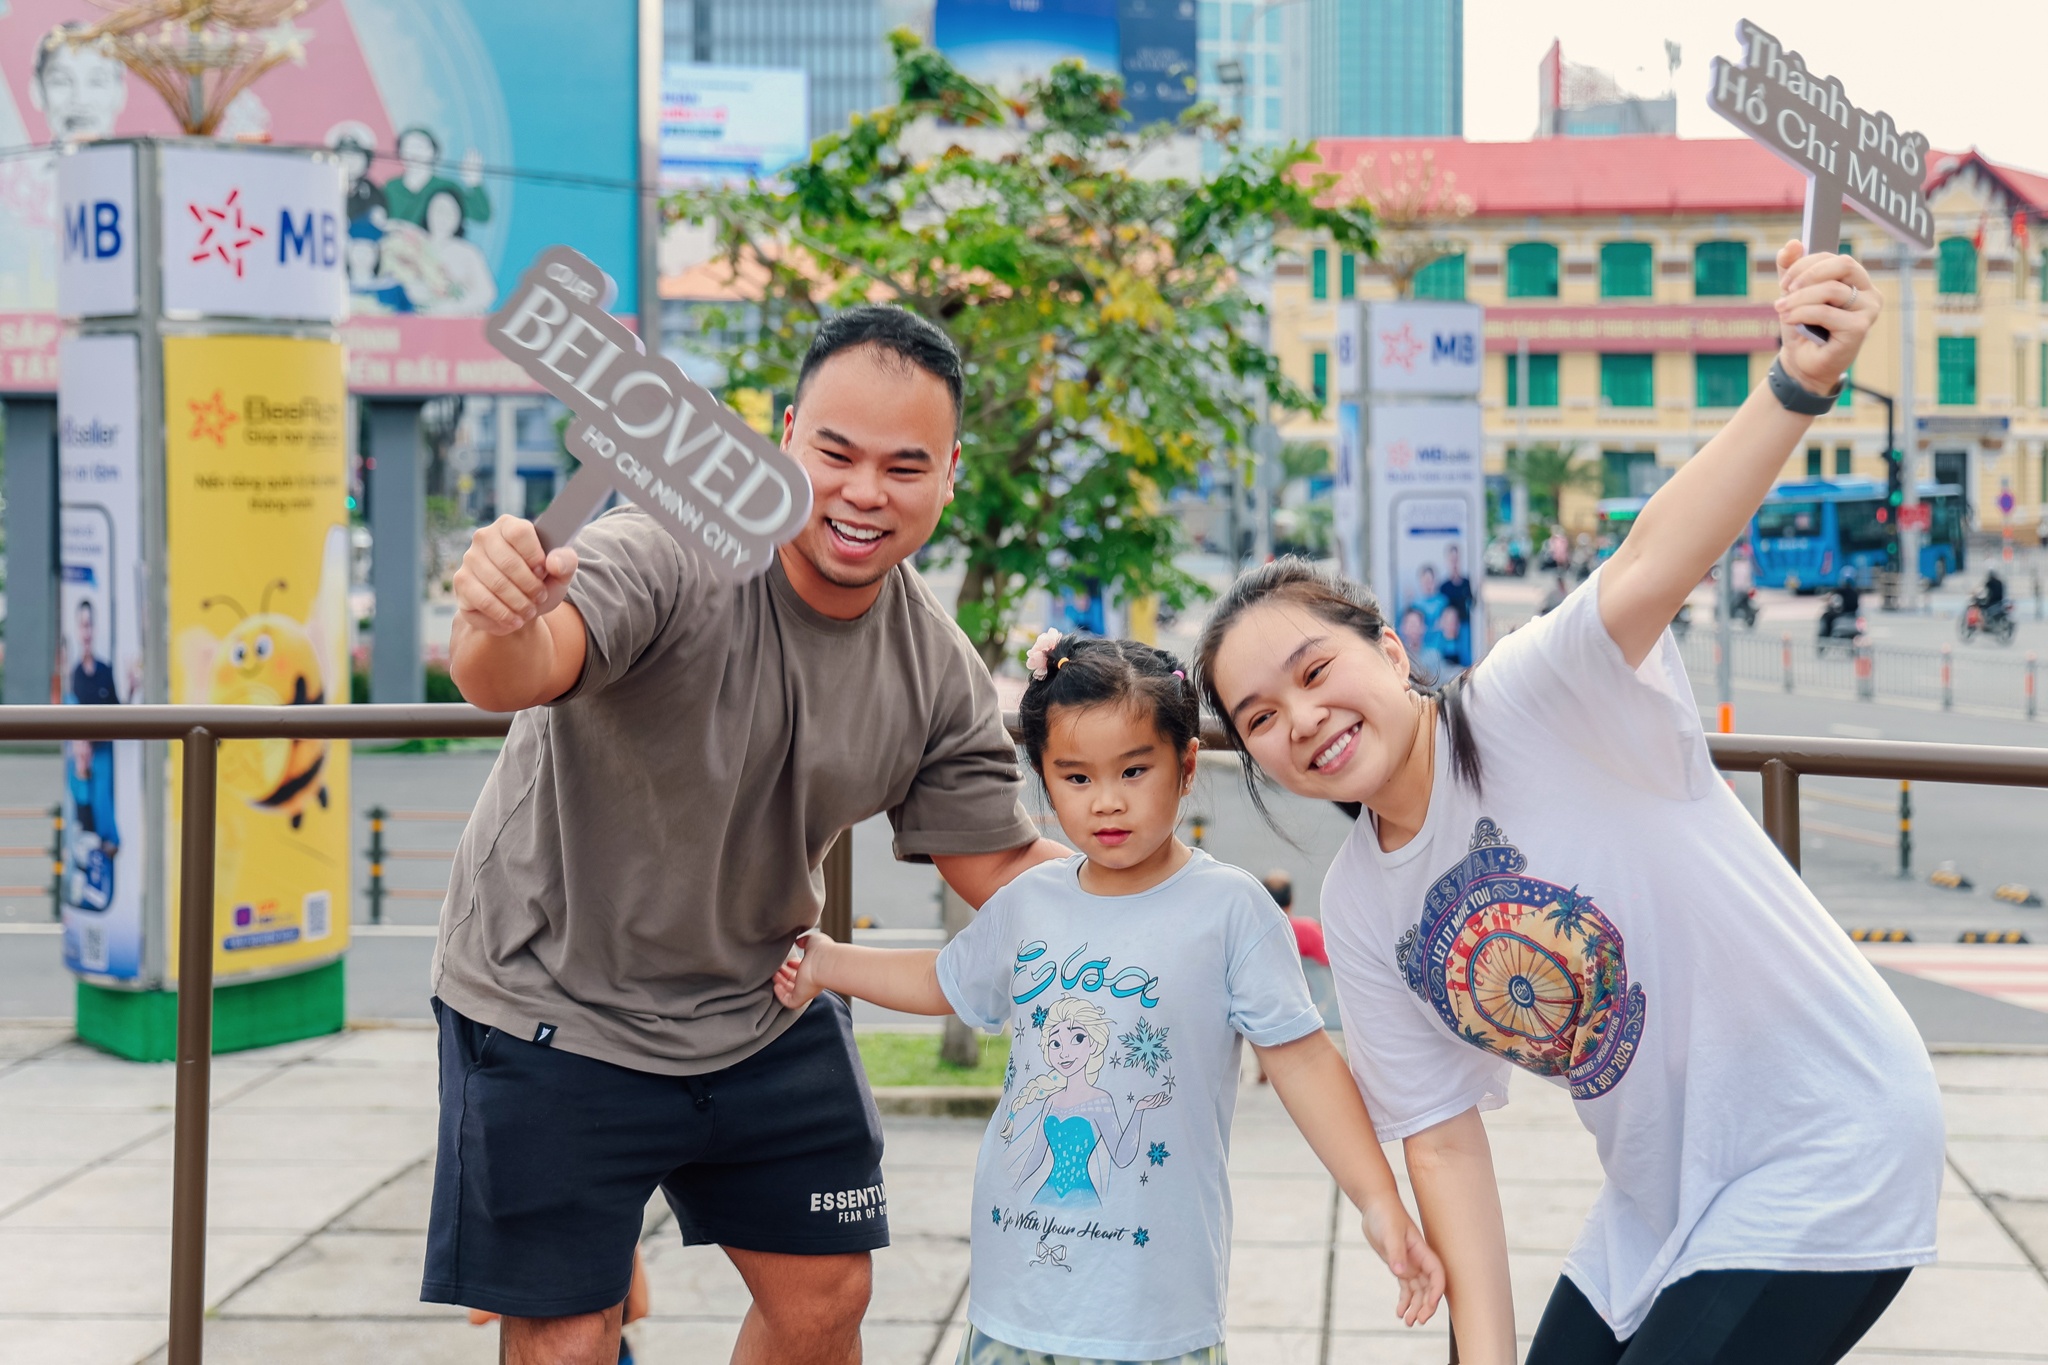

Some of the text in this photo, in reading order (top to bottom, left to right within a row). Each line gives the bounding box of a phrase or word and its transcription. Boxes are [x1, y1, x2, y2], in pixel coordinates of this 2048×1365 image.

[1745, 26, 1921, 177] Thành phố
[1776, 108, 1840, 175] Chí
[1847, 150, 1928, 239] Minh
[64, 202, 121, 261] MB
[280, 209, 336, 266] MB
[1432, 332, 1476, 365] MB
[498, 283, 792, 536] BELOVED
[1432, 886, 1491, 964] LET IT MOVE YOU
[1011, 939, 1160, 1008] Elsa
[1607, 1015, 1620, 1041] OFFERS
[1586, 1081, 1599, 1094] &
[1595, 1066, 1618, 1090] 30TH
[1611, 1040, 1633, 1071] 2026
[839, 1209, 862, 1223] FEAR
[865, 1207, 875, 1219] OF
[1014, 1210, 1041, 1231] With
[1040, 1216, 1075, 1241] Your
[1077, 1221, 1130, 1241] Heart
